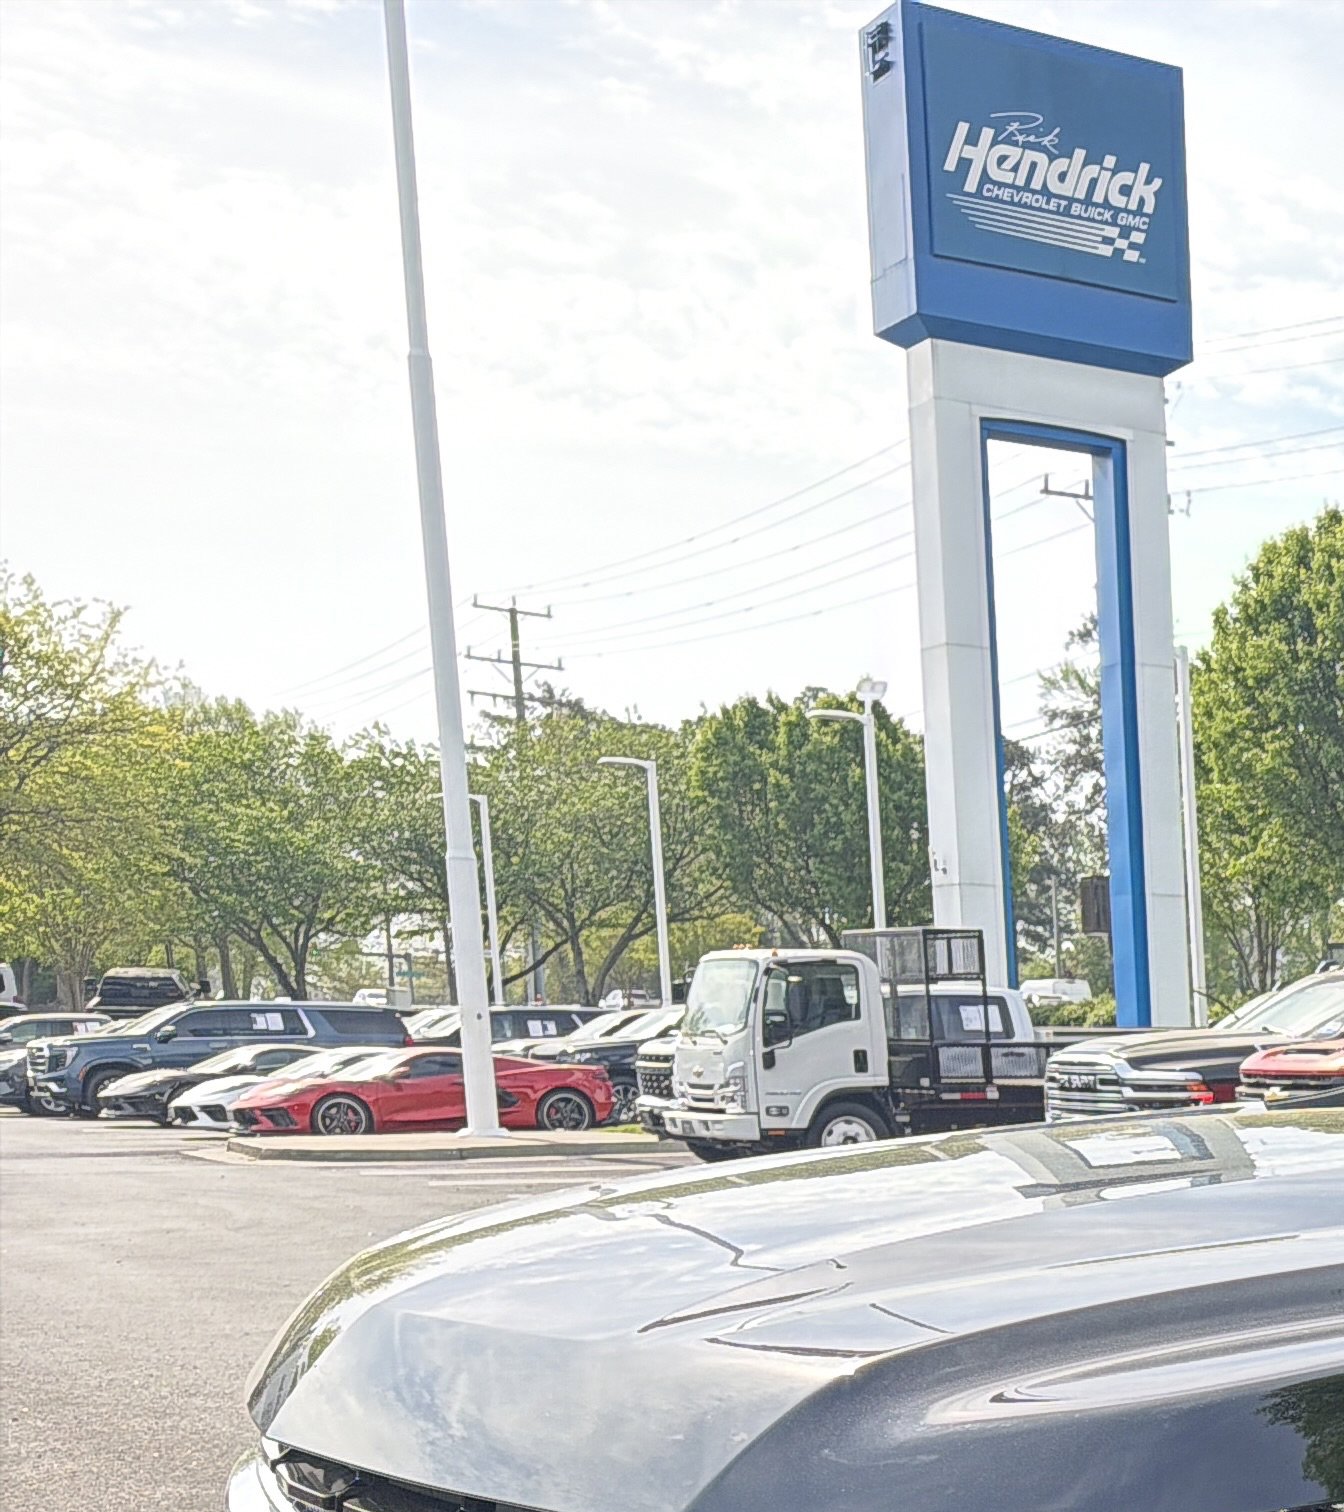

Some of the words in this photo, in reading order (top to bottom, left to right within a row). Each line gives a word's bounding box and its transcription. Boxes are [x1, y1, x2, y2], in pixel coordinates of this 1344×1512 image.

[990, 111, 1061, 155] Rick
[943, 120, 1163, 215] Hendrick
[982, 183, 1069, 213] CHEVROLET
[1070, 202, 1115, 223] BUICK
[1117, 212, 1150, 230] GMC
